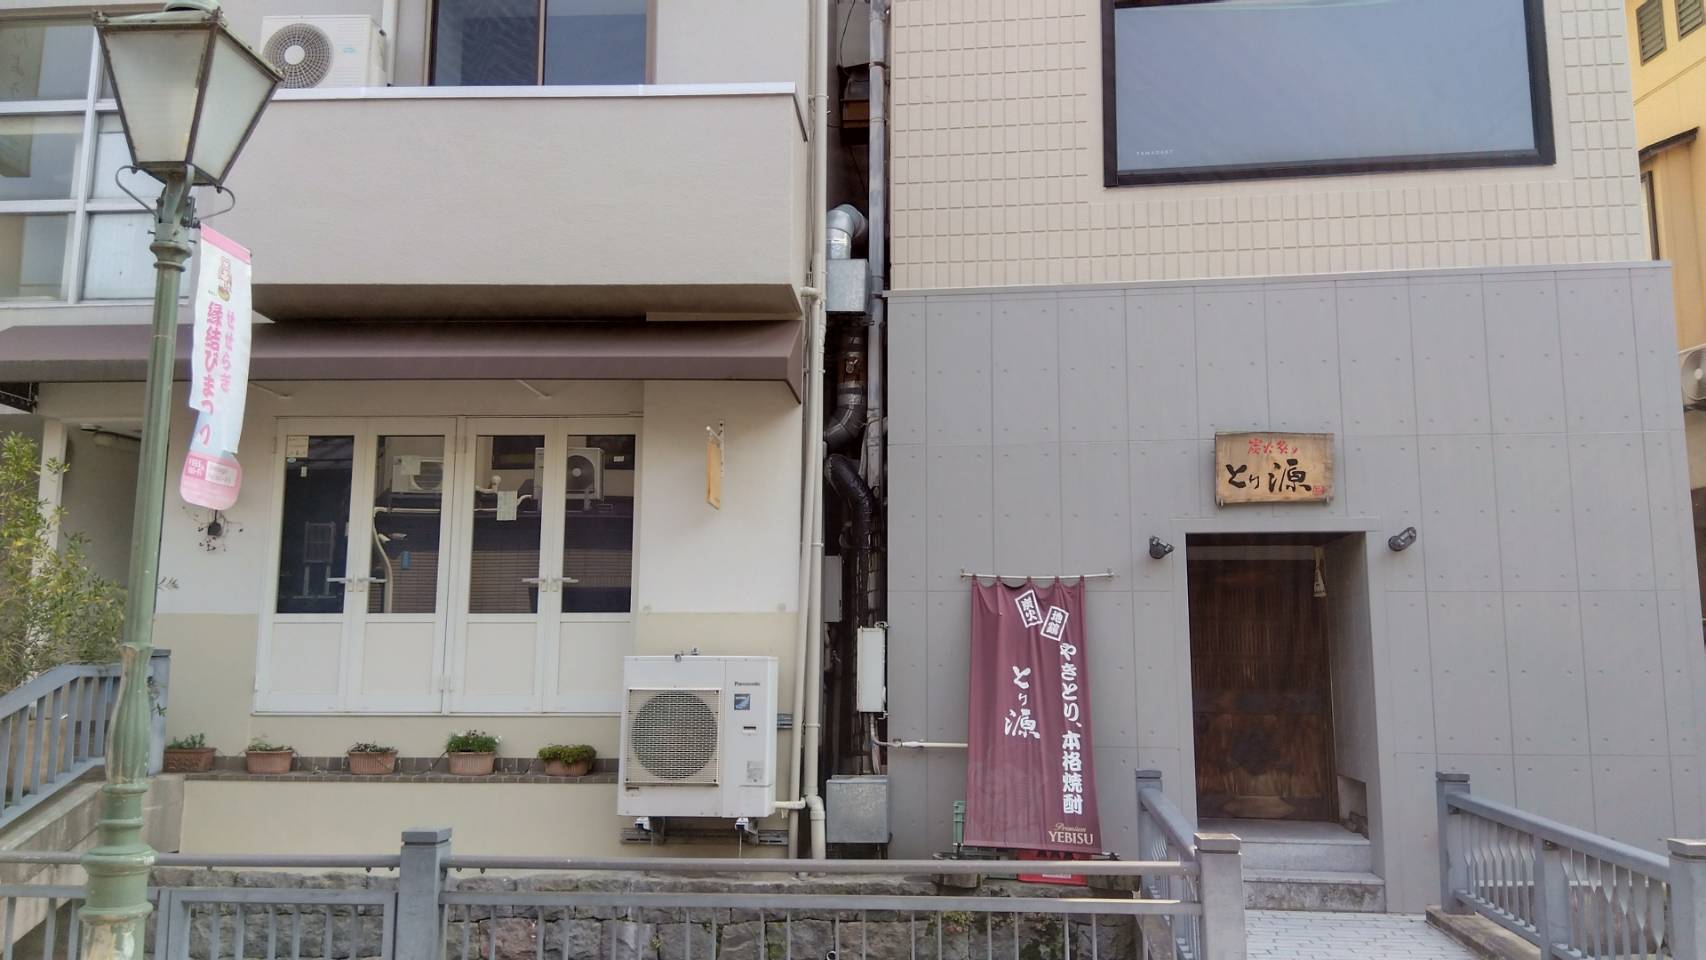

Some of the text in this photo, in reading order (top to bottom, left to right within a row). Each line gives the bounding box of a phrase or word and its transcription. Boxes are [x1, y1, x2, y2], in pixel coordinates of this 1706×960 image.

[1225, 458, 1312, 492] とり源
[1020, 596, 1038, 622] 炭火
[1004, 665, 1041, 739] とり源
[1048, 831, 1093, 845] YEBISU
